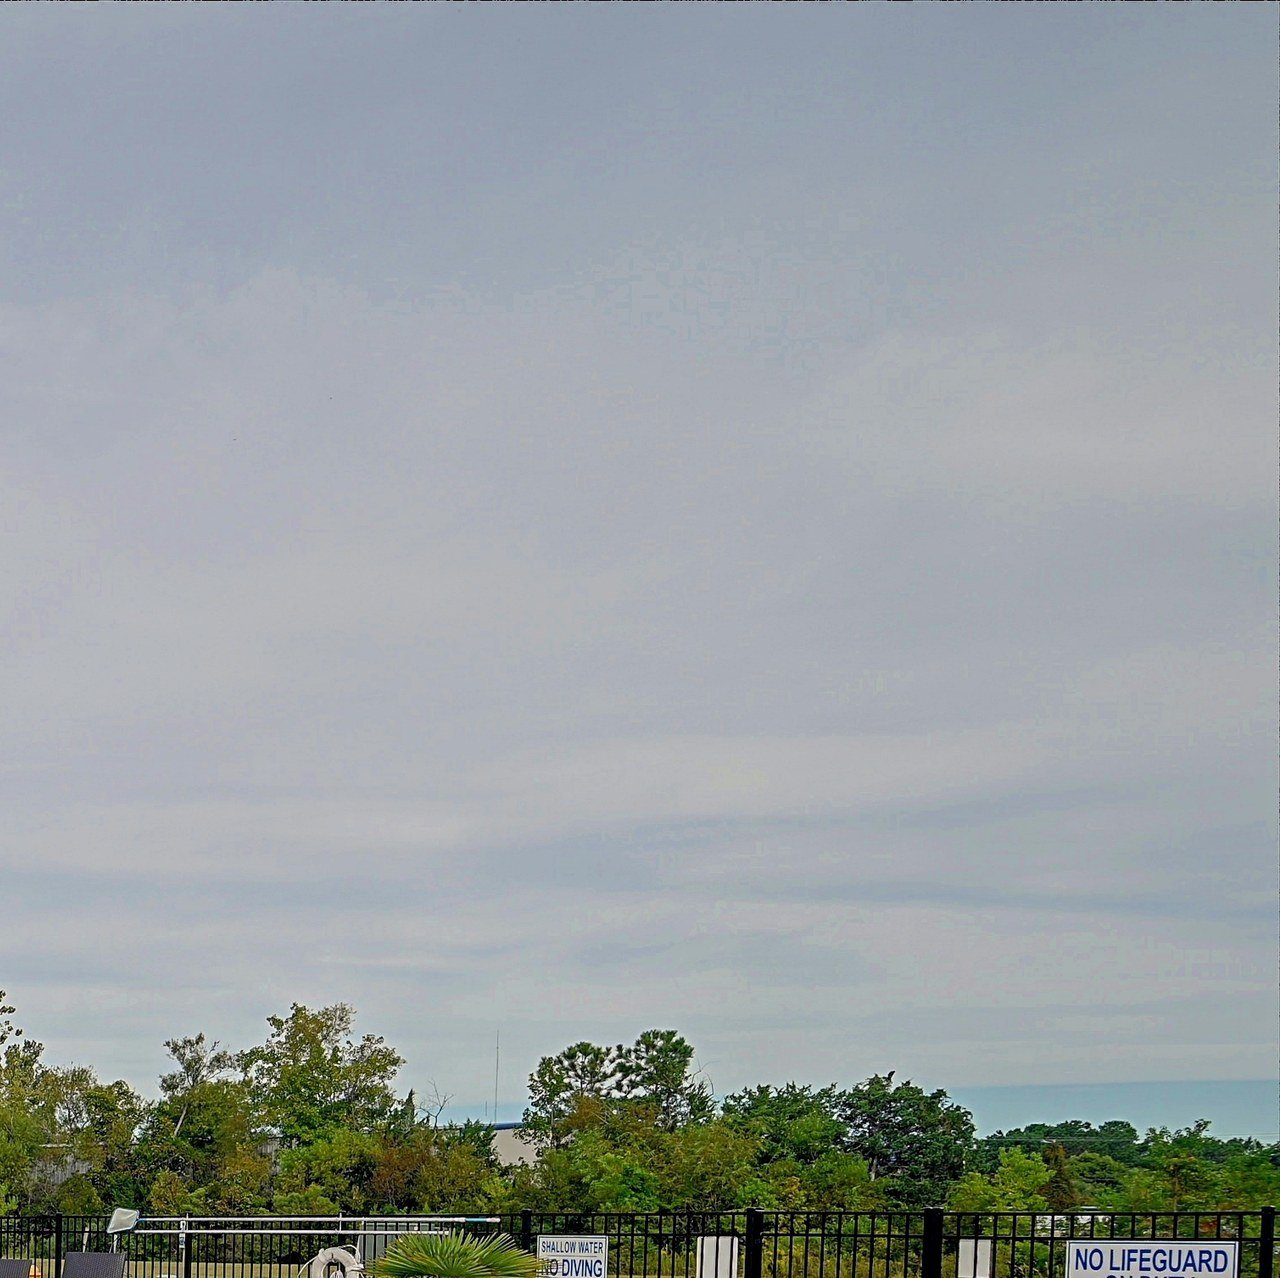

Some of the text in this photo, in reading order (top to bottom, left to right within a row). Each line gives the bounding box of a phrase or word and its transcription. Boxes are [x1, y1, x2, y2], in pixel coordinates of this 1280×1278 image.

[541, 1241, 603, 1254] SHALLOW WATER
[562, 1259, 603, 1277] DIVING
[1075, 1248, 1228, 1273] NO LIFEGUARD
